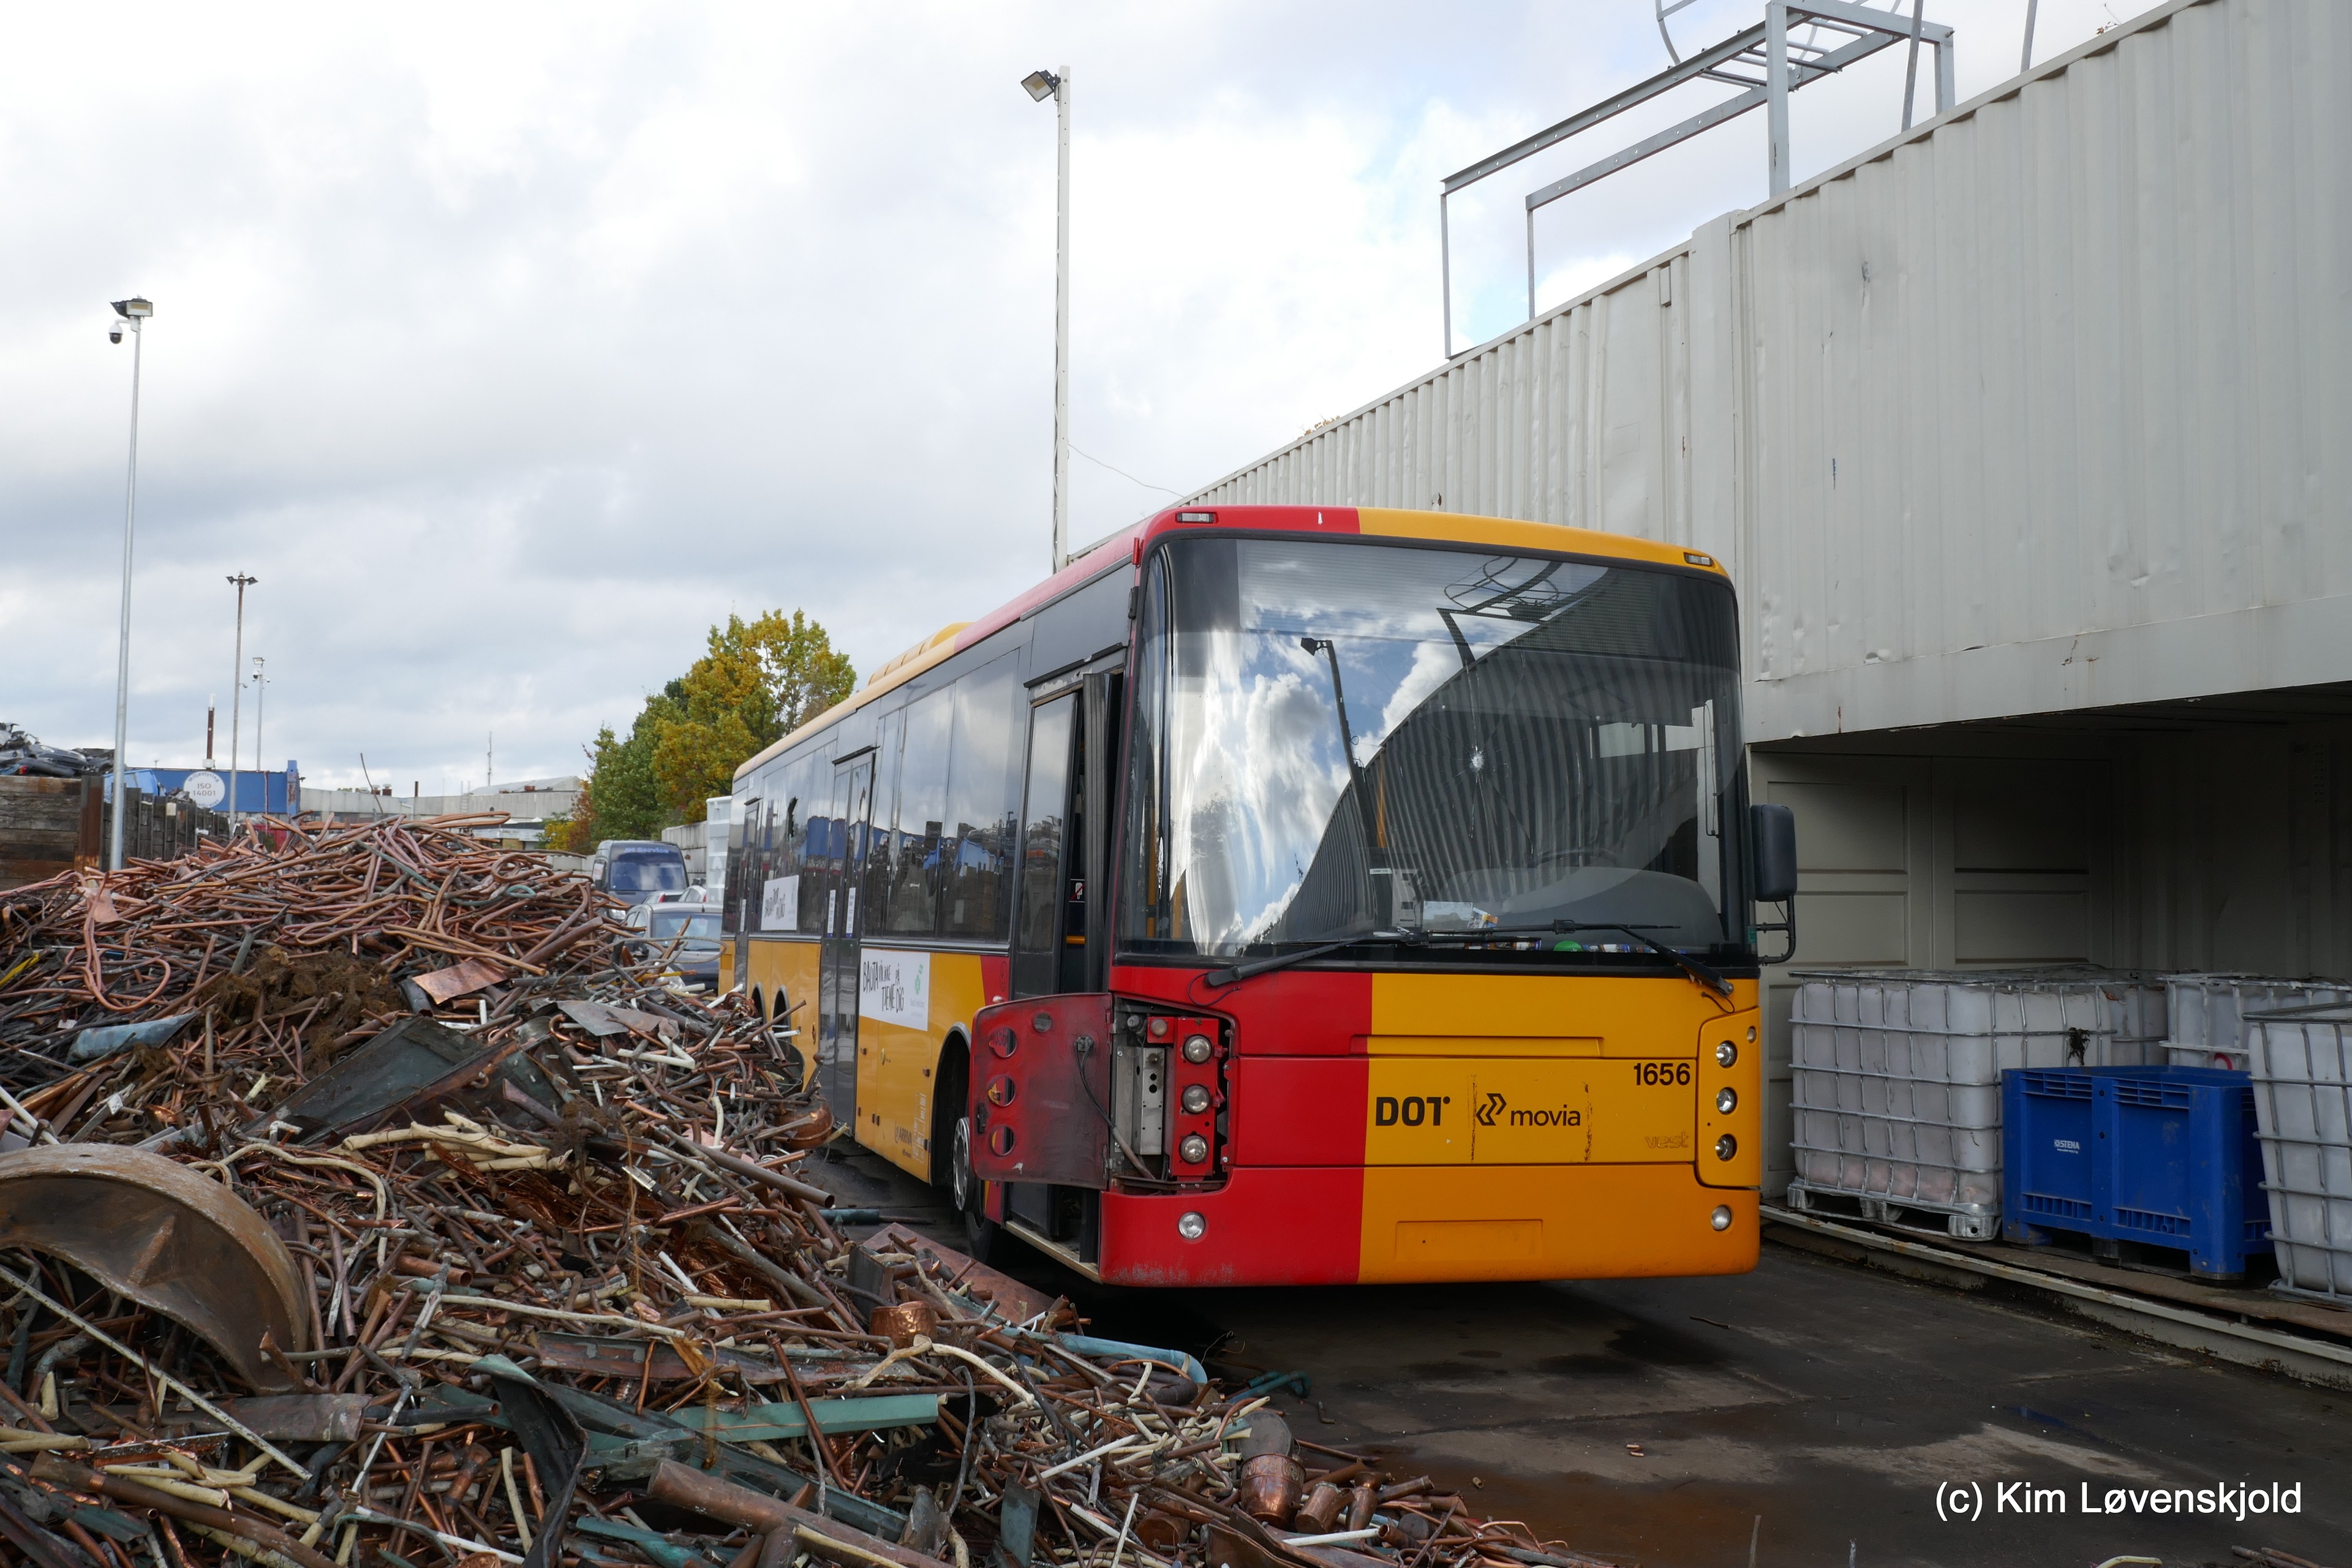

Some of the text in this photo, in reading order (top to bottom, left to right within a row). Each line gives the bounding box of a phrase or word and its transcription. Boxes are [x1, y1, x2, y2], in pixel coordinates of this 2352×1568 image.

[1634, 1063, 1691, 1085] 1656
[1376, 1096, 1580, 1126] DOT movia
[1645, 1132, 1689, 1148] vest
[2060, 1140, 2080, 1150] STENA
